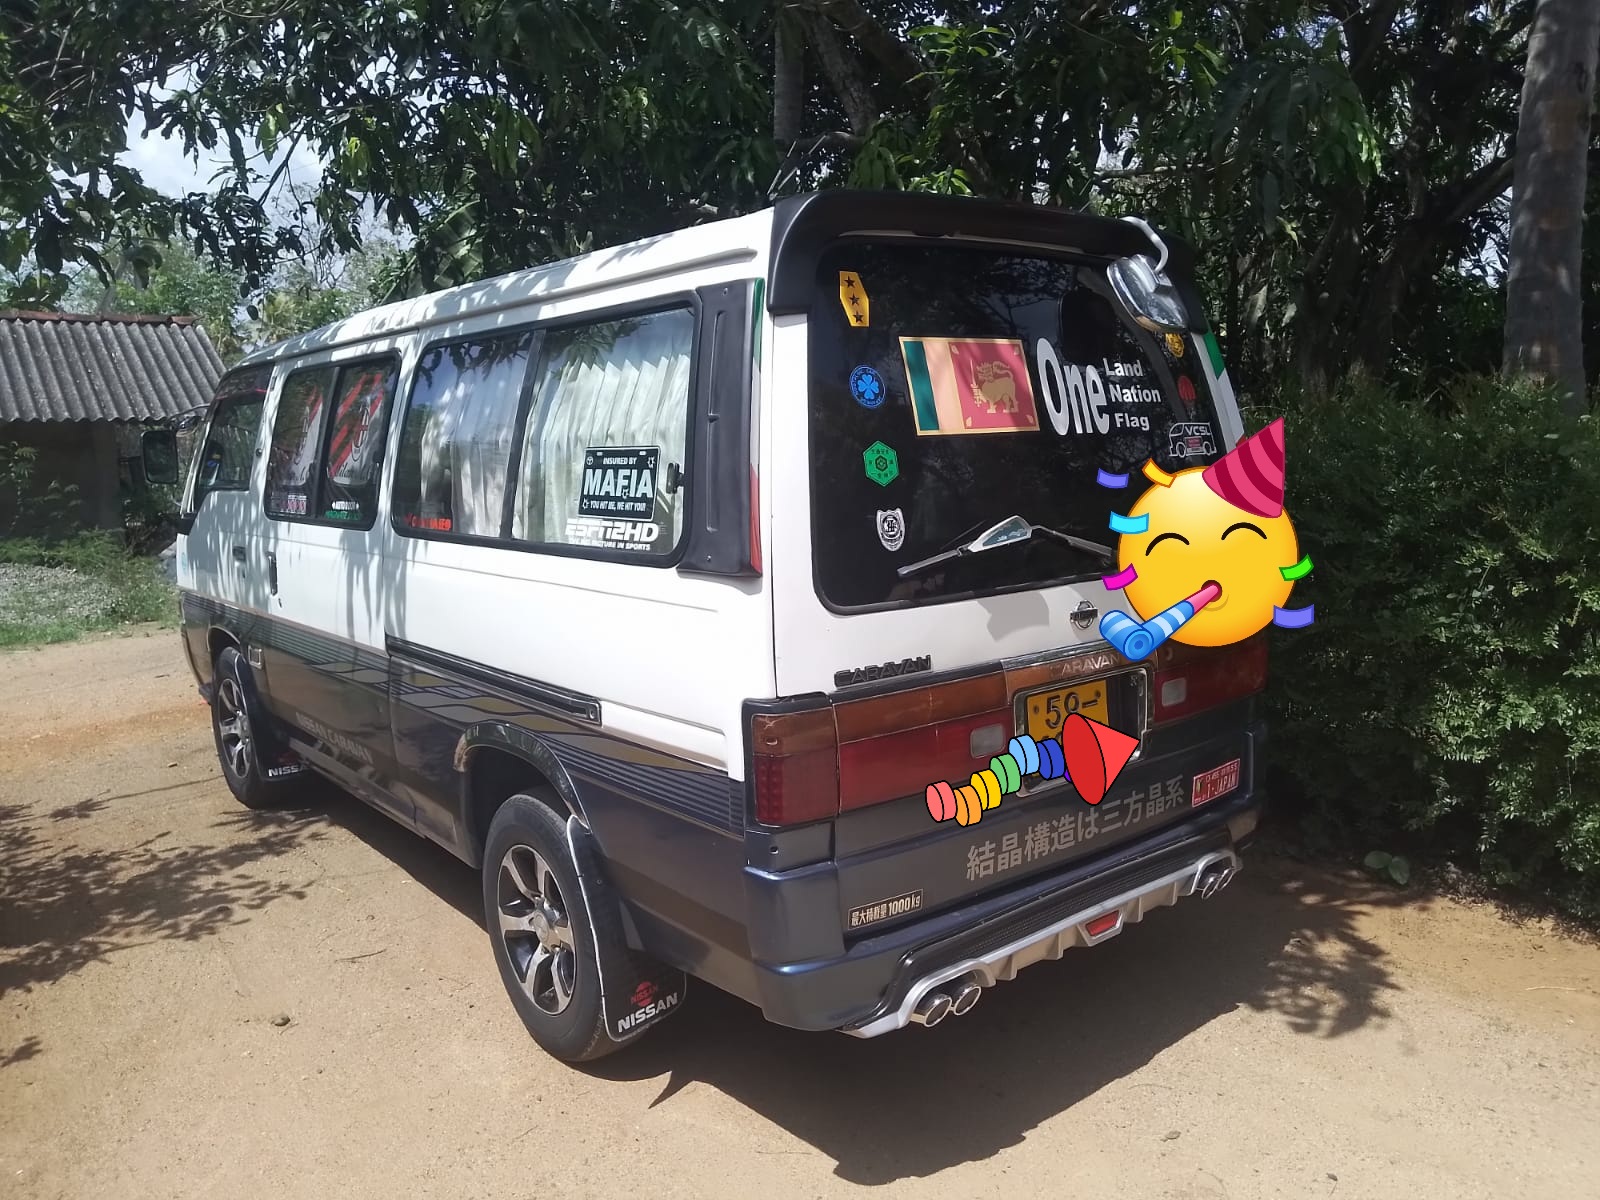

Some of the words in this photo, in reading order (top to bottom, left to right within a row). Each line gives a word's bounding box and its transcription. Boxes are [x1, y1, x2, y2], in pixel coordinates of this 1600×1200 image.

[1102, 357, 1144, 377] Land
[1036, 337, 1110, 436] One
[1108, 384, 1162, 403] Nation
[1114, 412, 1150, 431] Flag
[1184, 425, 1211, 436] VCSL
[603, 457, 628, 465] INSURED
[628, 456, 638, 465] BY
[583, 468, 654, 498] MAFIA
[625, 543, 651, 551] SPORTS
[834, 654, 931, 688] CARAVAN
[268, 763, 307, 777] NISSA
[966, 774, 1185, 881] 結晶構造は三方晶系
[617, 992, 678, 1033] NISSAN
